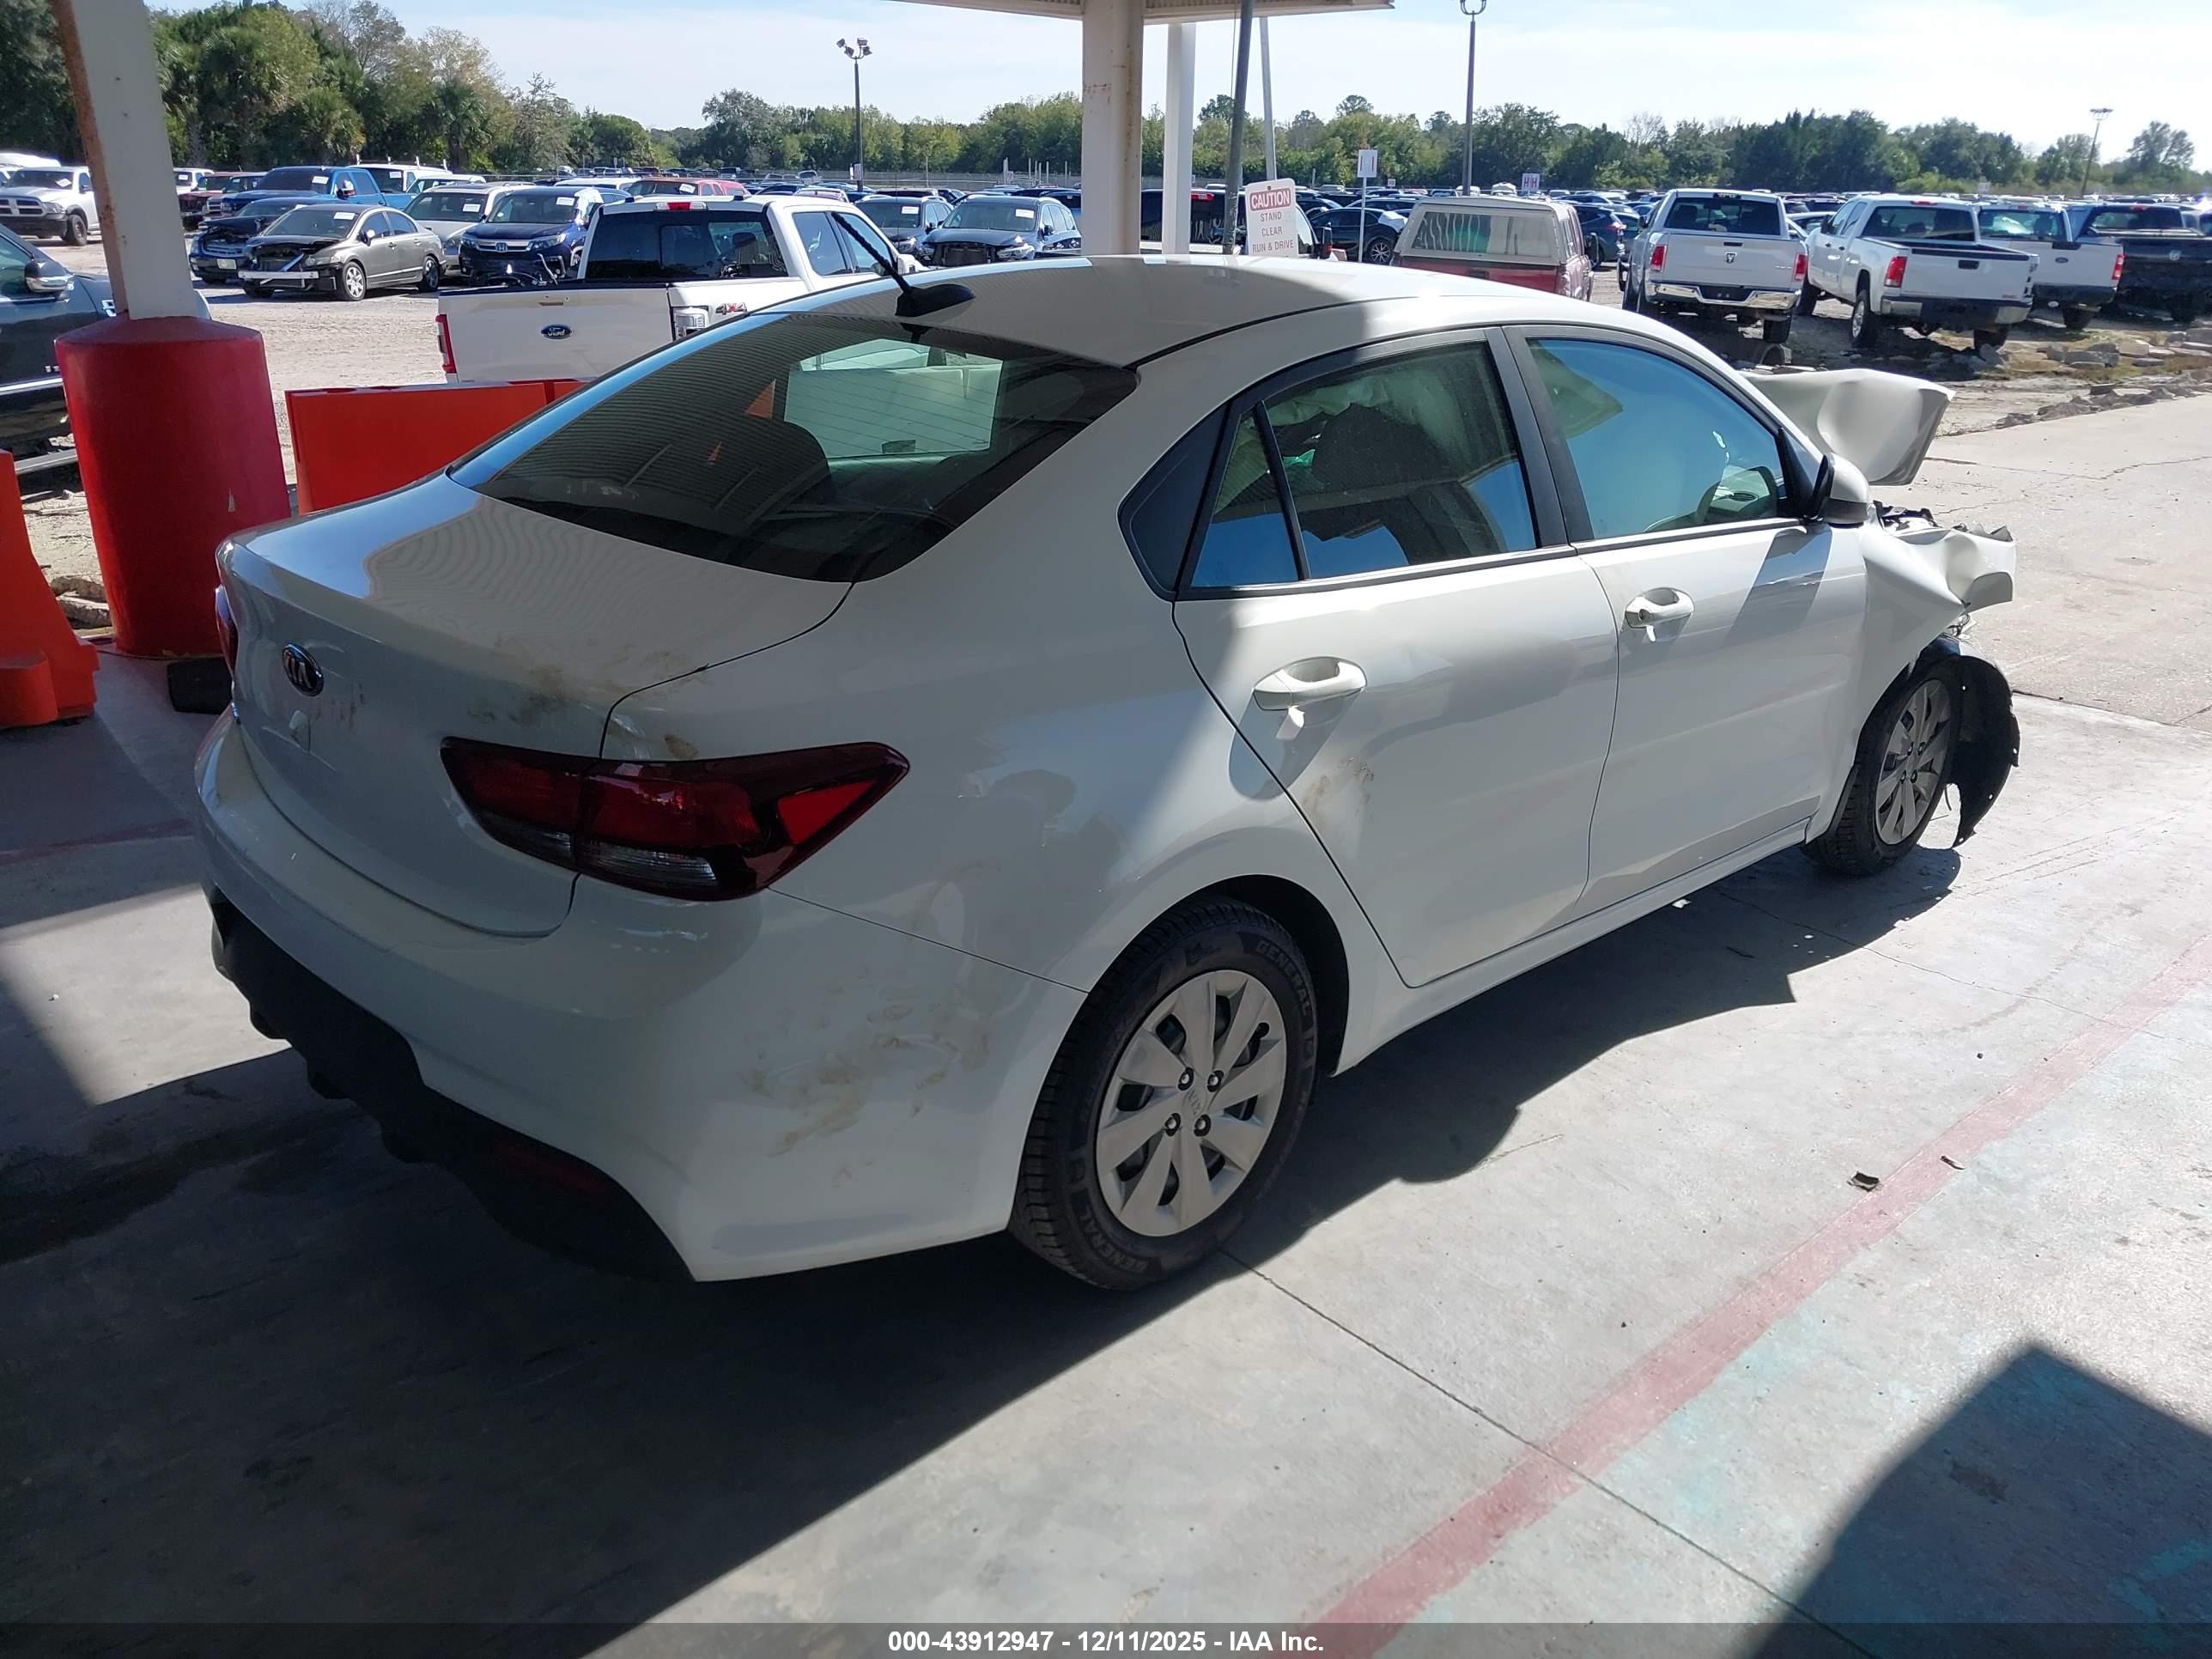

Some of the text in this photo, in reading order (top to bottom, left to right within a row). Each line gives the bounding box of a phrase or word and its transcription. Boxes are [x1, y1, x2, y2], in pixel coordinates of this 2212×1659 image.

[1251, 190, 1290, 209] CAUTION
[1260, 211, 1282, 222] STAND
[1261, 226, 1283, 237] CLEAR
[1252, 240, 1294, 253] RUN & DRIVE
[1255, 939, 1313, 1018] GENERAL
